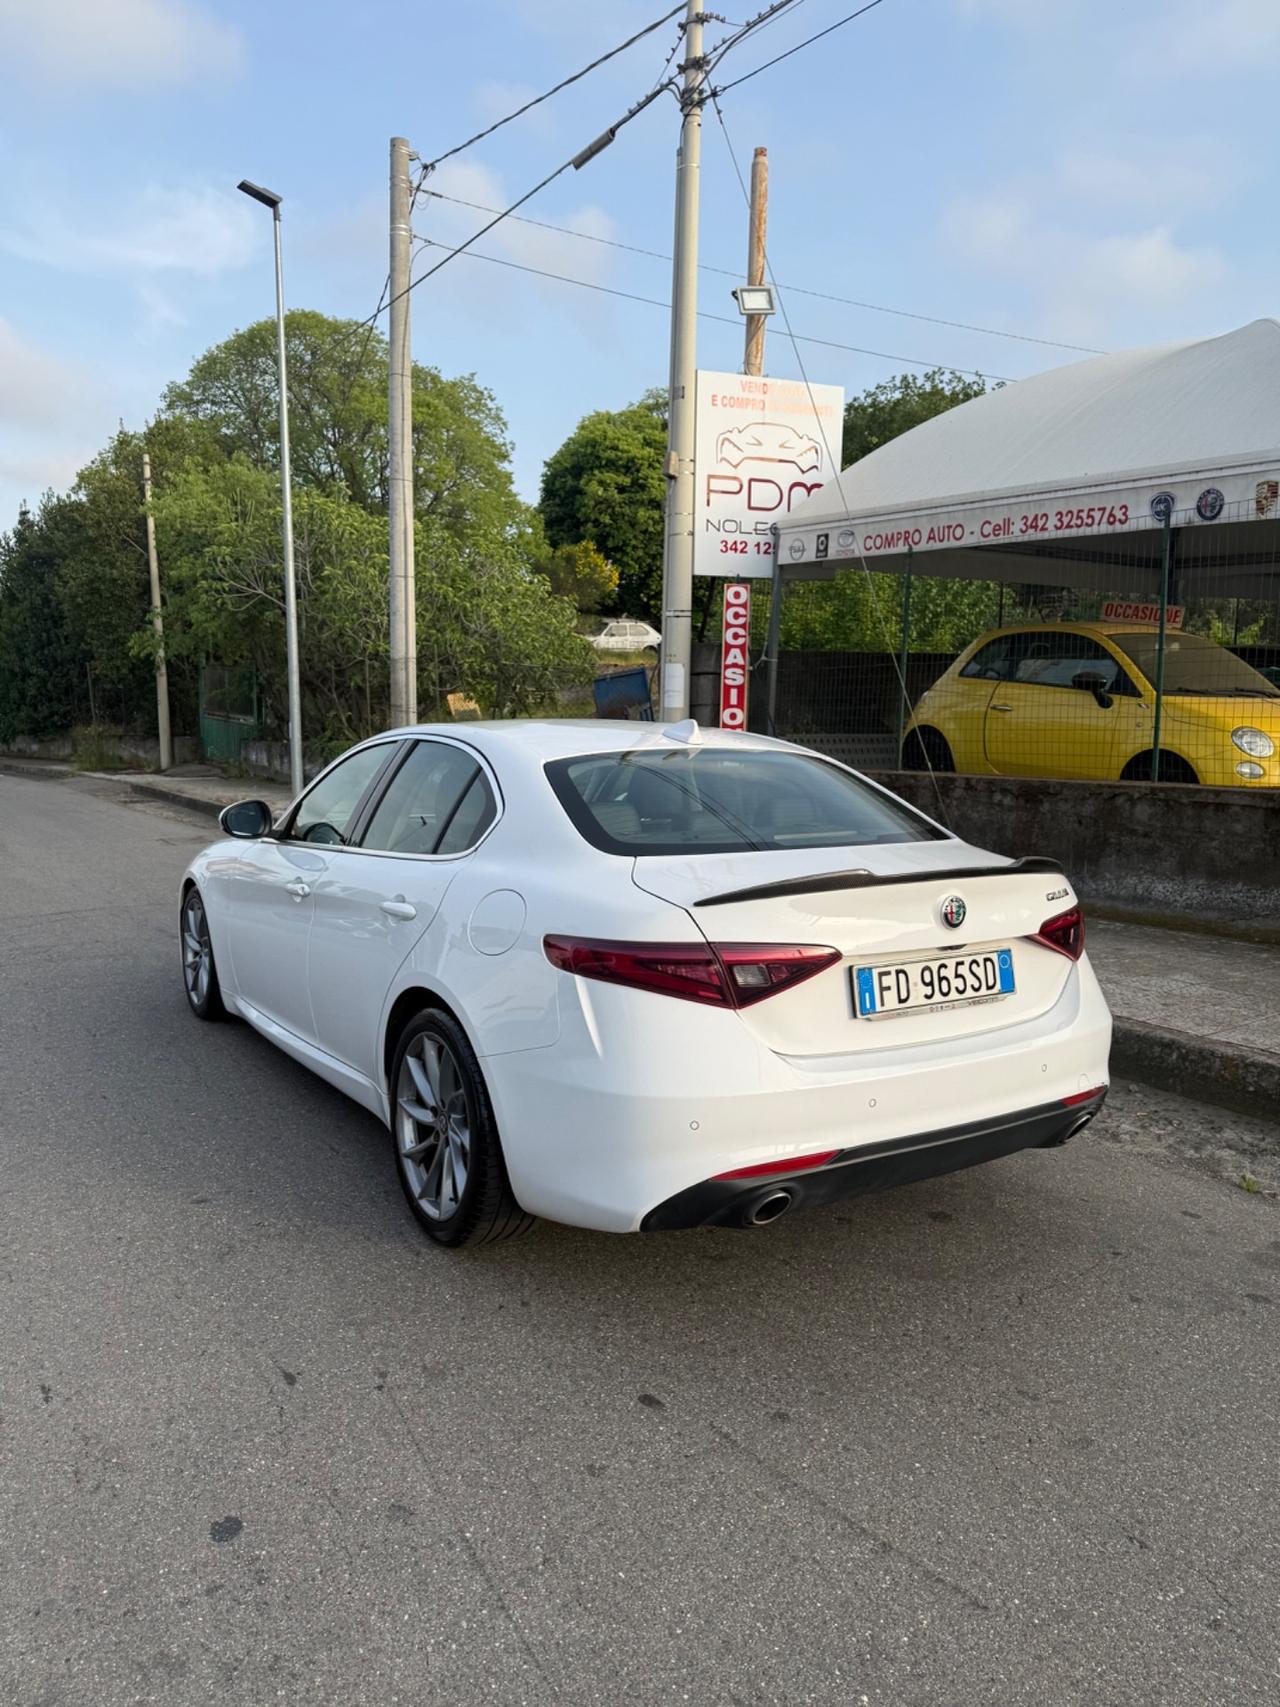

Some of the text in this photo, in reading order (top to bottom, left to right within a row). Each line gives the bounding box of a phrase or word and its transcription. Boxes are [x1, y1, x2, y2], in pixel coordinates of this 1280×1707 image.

[711, 394, 718, 407] E
[721, 395, 766, 411] COMPRO
[720, 539, 748, 554] 342
[863, 530, 923, 551] COMPRO
[926, 523, 965, 544] AUTO
[980, 516, 1015, 537] Cell:
[1019, 513, 1049, 534] 342
[1053, 504, 1129, 531] 3255763
[722, 586, 748, 731] OCCASIO
[877, 957, 998, 1007] FD 965SD
